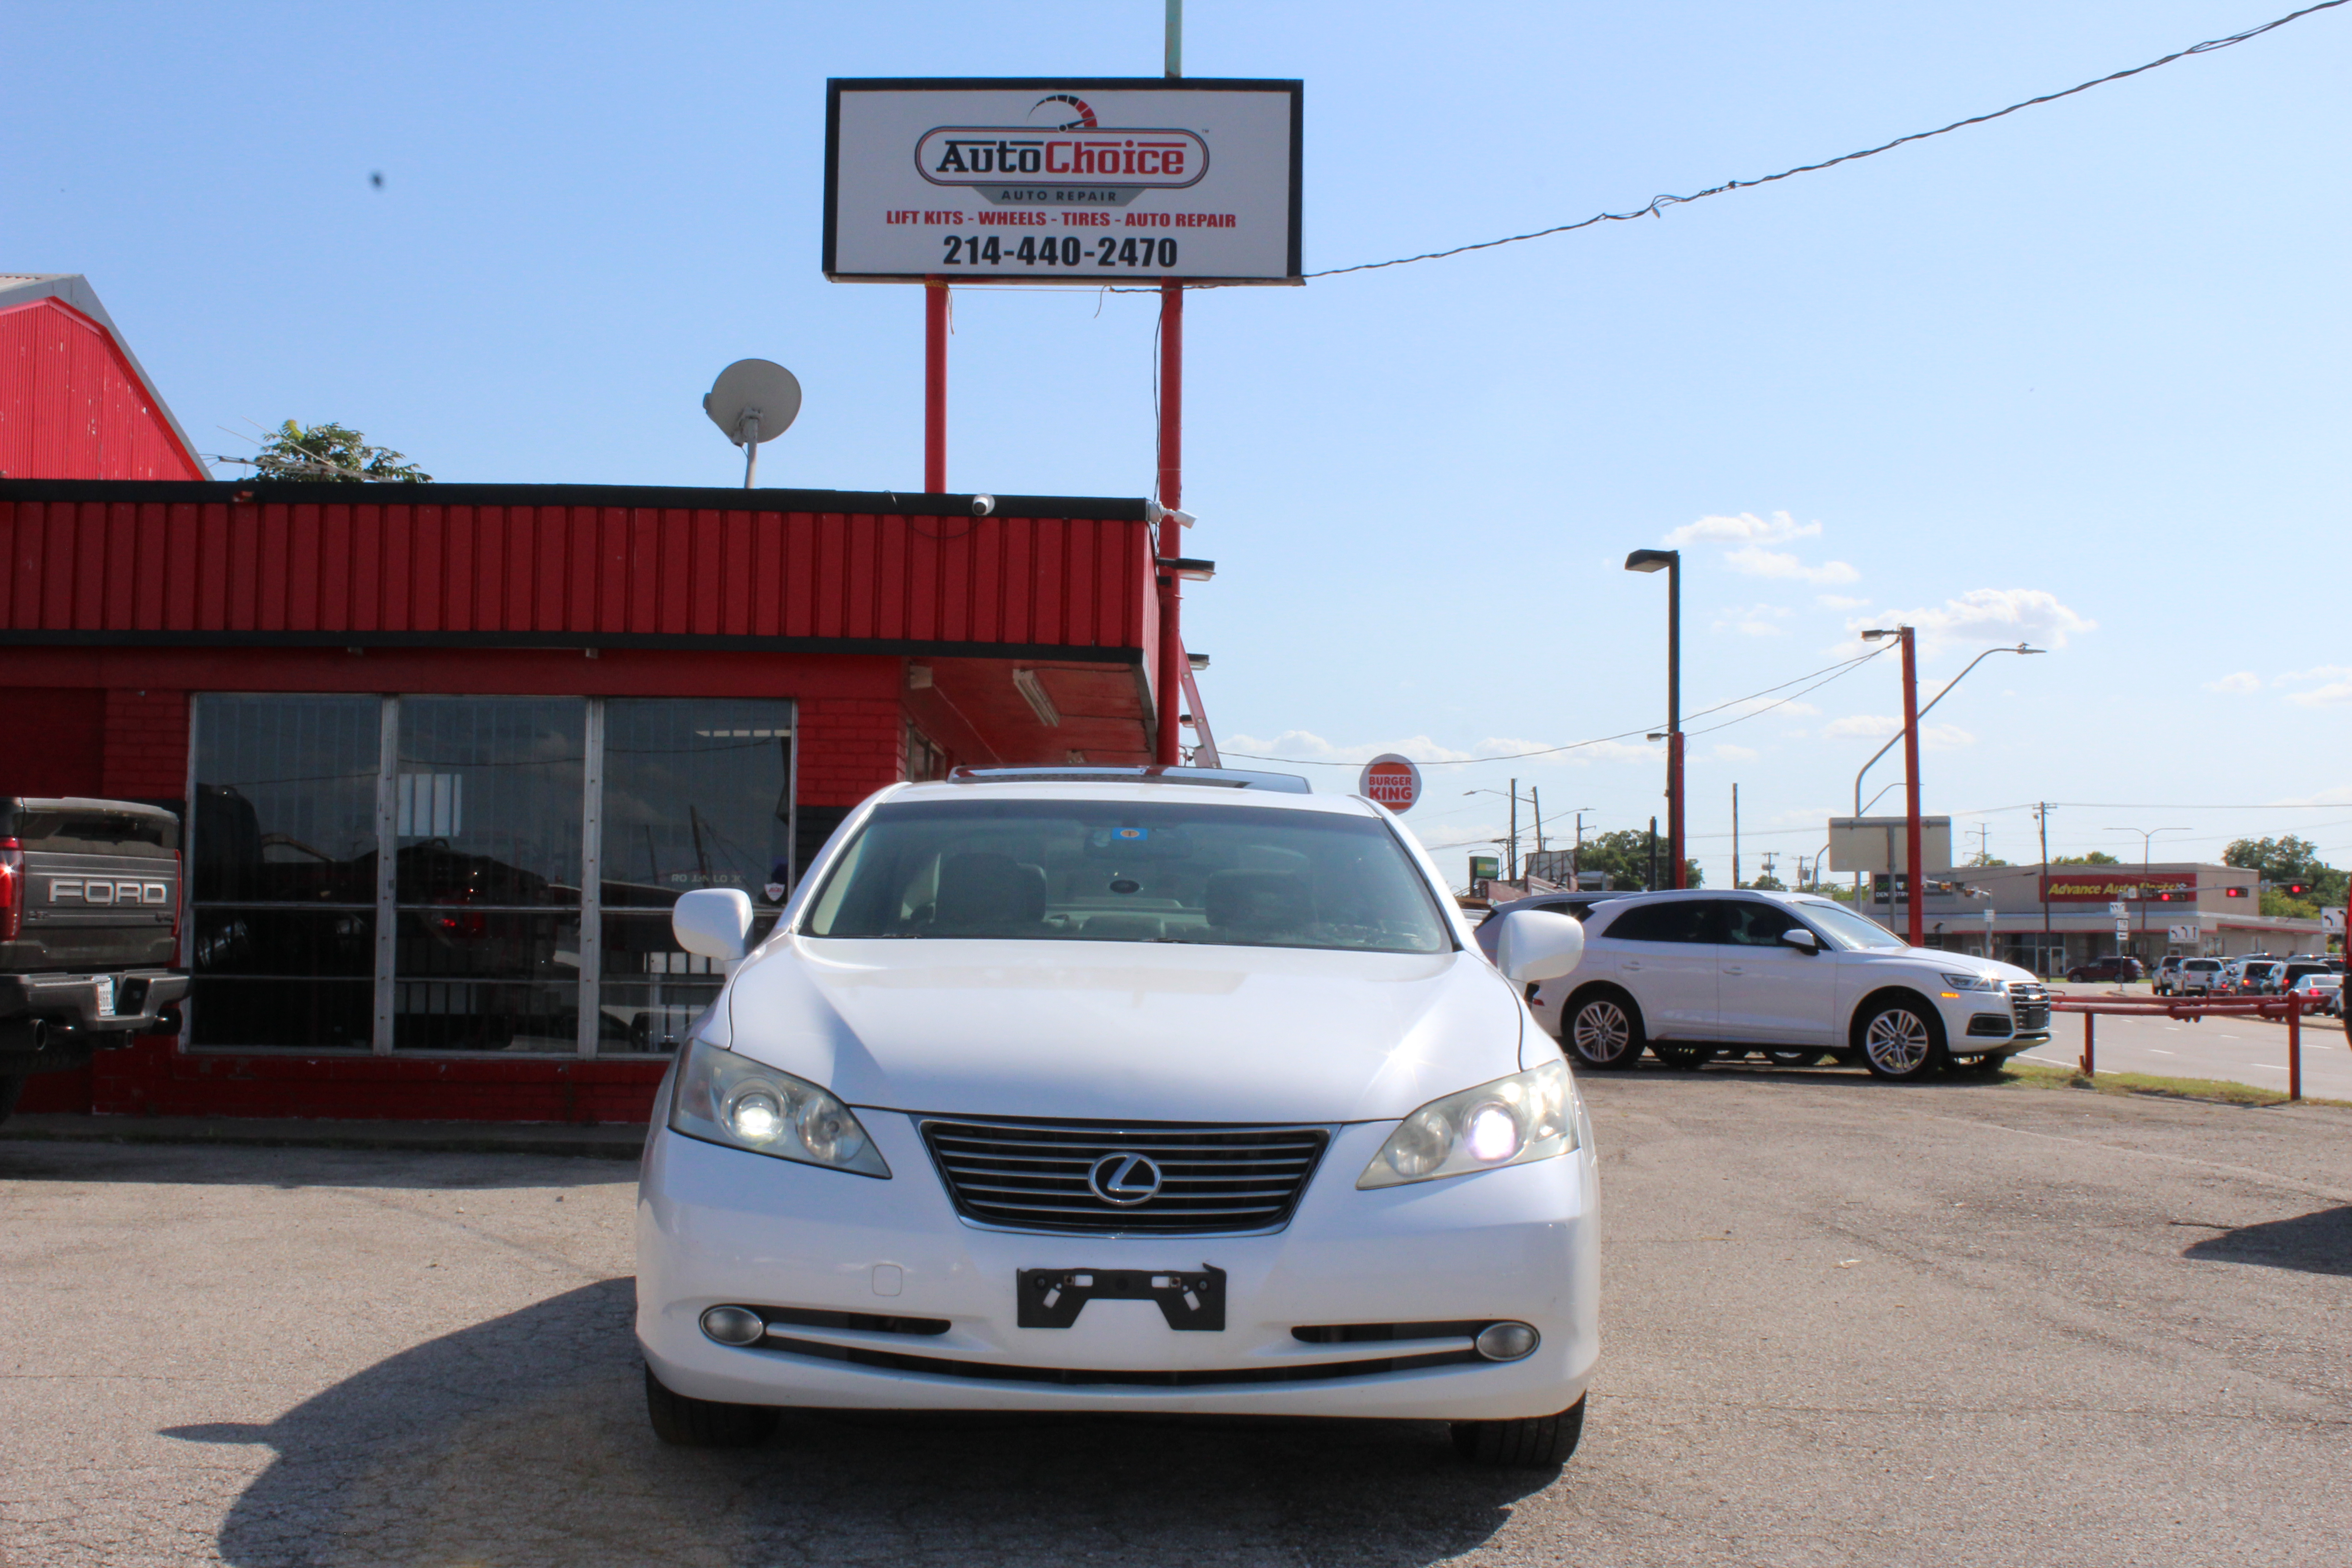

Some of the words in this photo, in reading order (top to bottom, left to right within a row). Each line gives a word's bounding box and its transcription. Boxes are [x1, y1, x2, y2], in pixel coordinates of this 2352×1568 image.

[936, 140, 1186, 175] AutoChoice
[1001, 190, 1047, 201] AUTO
[1056, 191, 1116, 201] REPAIR
[887, 211, 920, 224] LIFT
[924, 211, 963, 225] KITS
[978, 211, 1047, 225] WHEELS
[1061, 212, 1111, 226] TIRES
[1125, 213, 1171, 227] AUTO
[1176, 214, 1236, 227] REPAIR
[943, 235, 1177, 268] 214-440-2470
[1368, 776, 1412, 786] BURGER
[1369, 787, 1413, 800] KING
[49, 879, 167, 904] FORD
[2048, 883, 2101, 894] Advance
